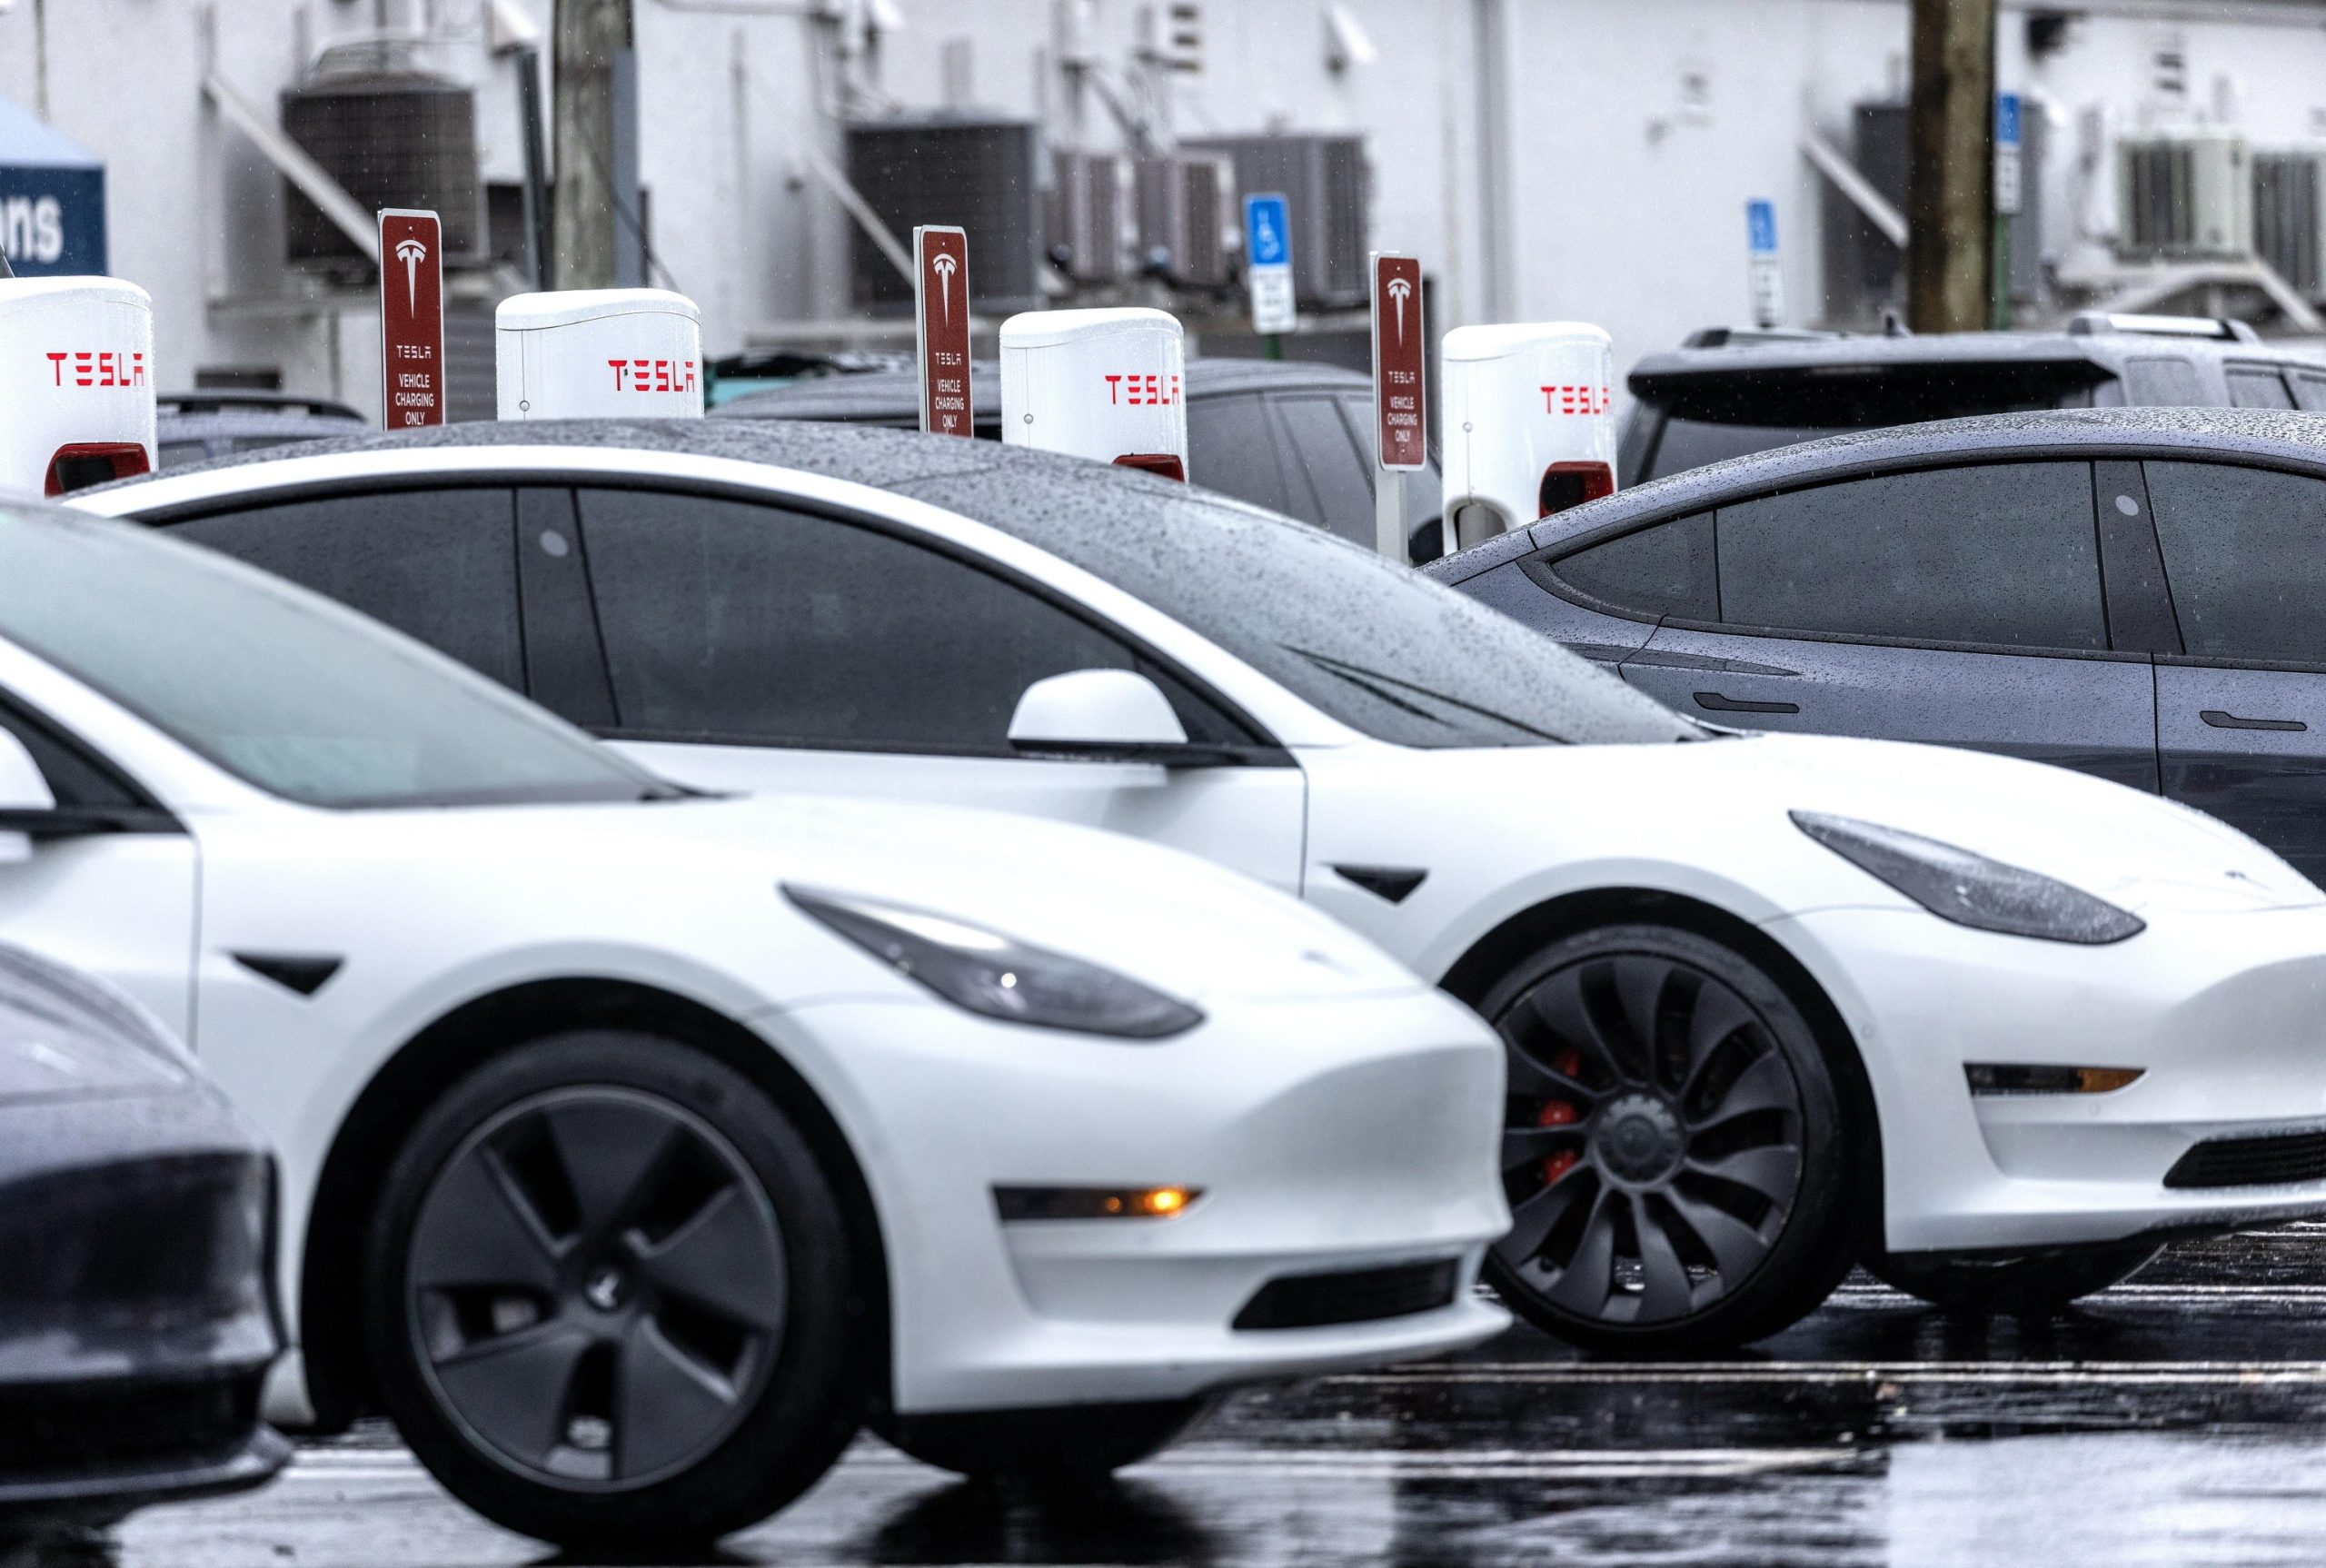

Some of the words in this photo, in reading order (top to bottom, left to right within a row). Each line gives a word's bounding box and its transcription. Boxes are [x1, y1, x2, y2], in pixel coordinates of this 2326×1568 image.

[0, 194, 64, 263] ns
[395, 344, 432, 359] TESLA
[935, 352, 962, 365] TESLA
[46, 352, 144, 386] TESLA
[608, 360, 695, 392] TESLA
[398, 373, 431, 389] VEHICLE
[1387, 371, 1416, 383] TESLA
[937, 379, 961, 393] VEHICLE
[1105, 375, 1180, 405] TESLA
[395, 392, 434, 407] CHARGING
[935, 397, 964, 411] CHARGING
[1389, 396, 1415, 410] VEHICLE
[1540, 386, 1611, 414] TESLA
[405, 411, 425, 426] ONLY
[942, 414, 958, 429] ONLY
[1387, 412, 1417, 426] CHARGING
[1395, 430, 1411, 442] ONLY
